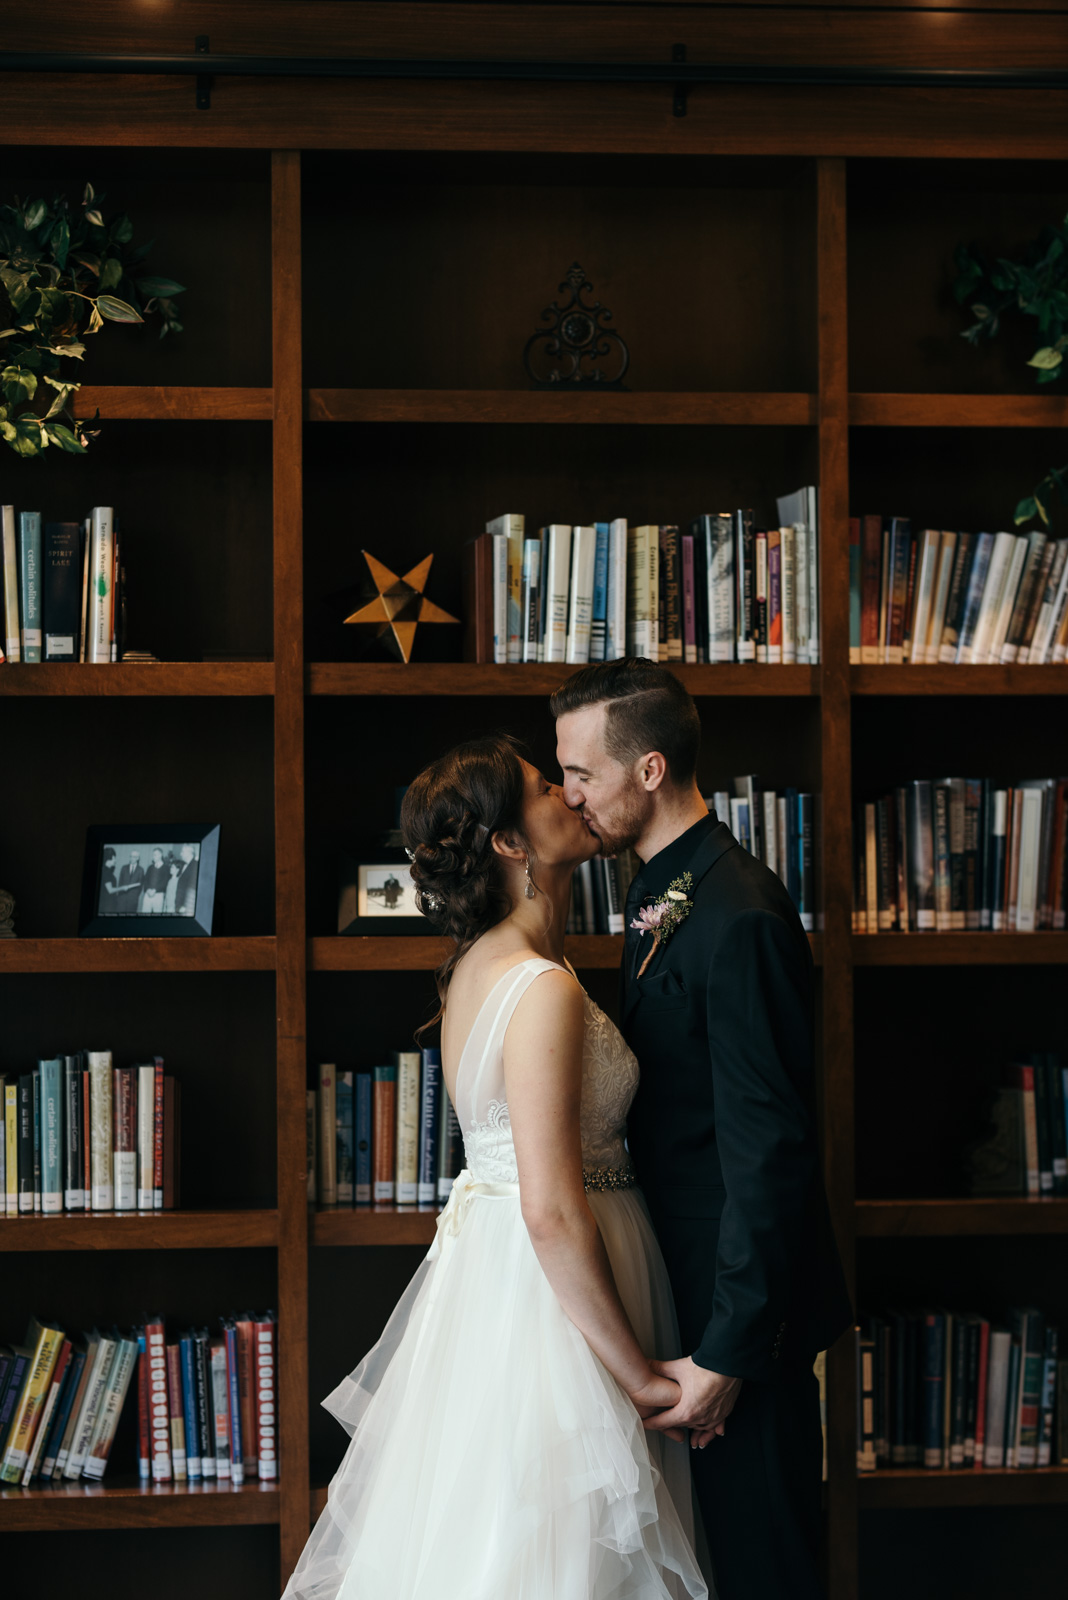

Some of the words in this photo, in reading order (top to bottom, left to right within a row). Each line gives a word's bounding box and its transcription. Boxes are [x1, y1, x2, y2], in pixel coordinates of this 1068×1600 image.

[28, 549, 37, 579] certain
[666, 532, 676, 580] McPherson
[28, 581, 37, 619] solitudes
[427, 1064, 440, 1086] bel
[48, 1098, 56, 1128] certain
[425, 1088, 435, 1128] canto
[48, 1130, 57, 1168] solitudes
[86, 1377, 106, 1414] Praisesong
[105, 1351, 132, 1414] GOODHOUSE
[83, 1424, 92, 1434] the
[86, 1413, 95, 1423] for
